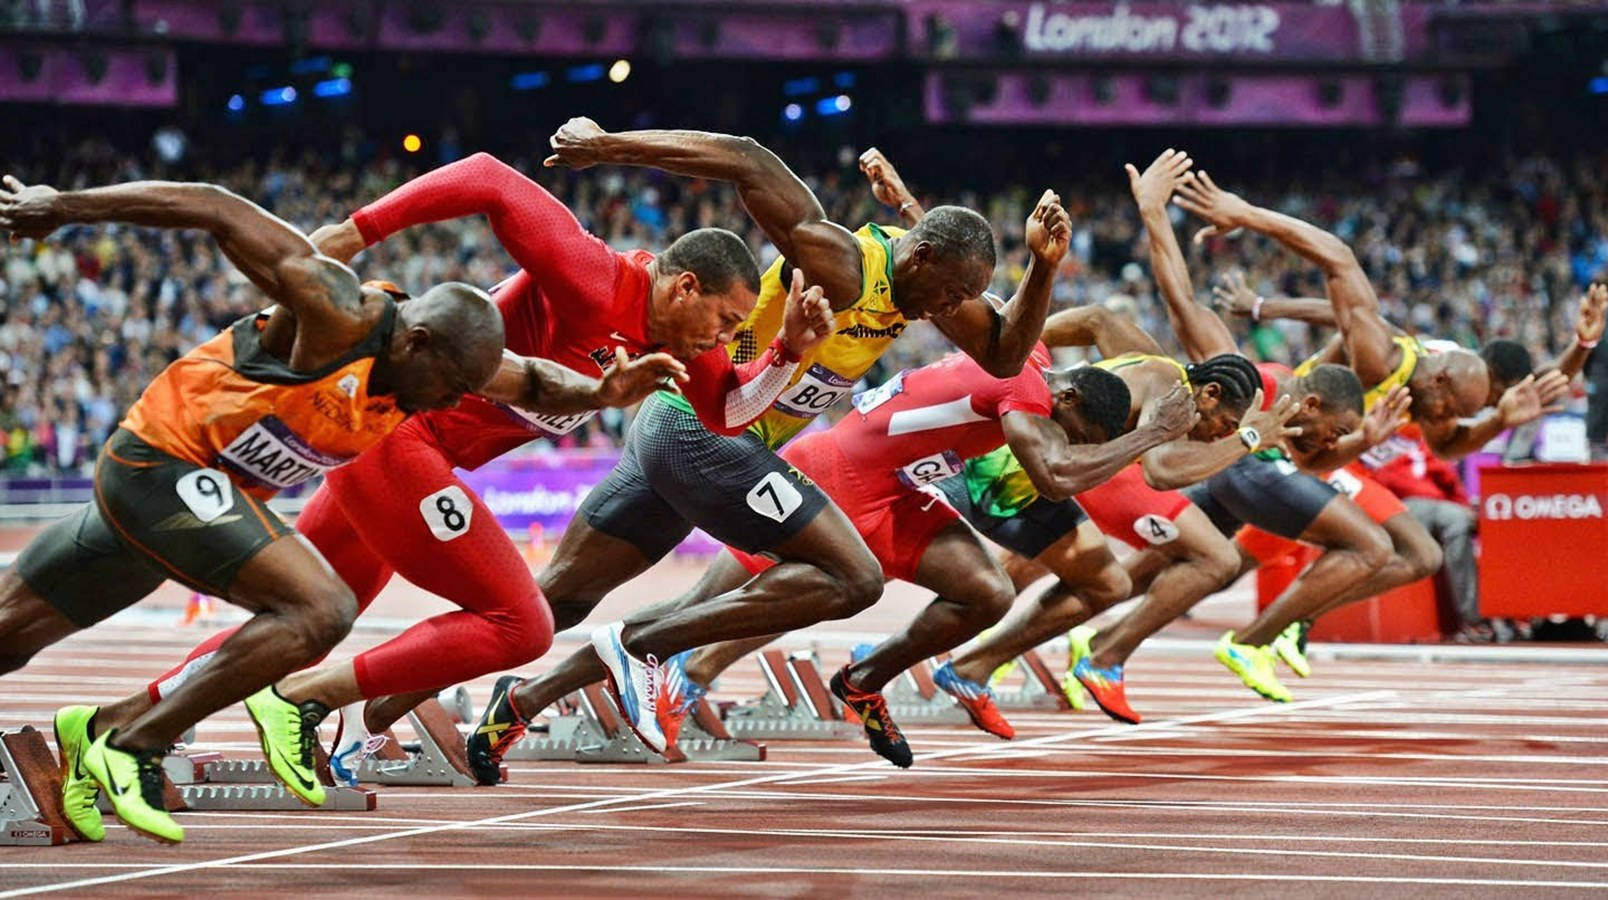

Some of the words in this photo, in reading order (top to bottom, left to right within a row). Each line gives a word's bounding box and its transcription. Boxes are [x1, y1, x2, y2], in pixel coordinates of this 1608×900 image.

[1025, 3, 1178, 50] London
[1182, 5, 1280, 50] 2012
[196, 475, 224, 507] 9
[756, 481, 785, 516] 7
[1515, 495, 1602, 519] OMEGA
[436, 495, 466, 532] 8
[1149, 517, 1168, 539] 4
